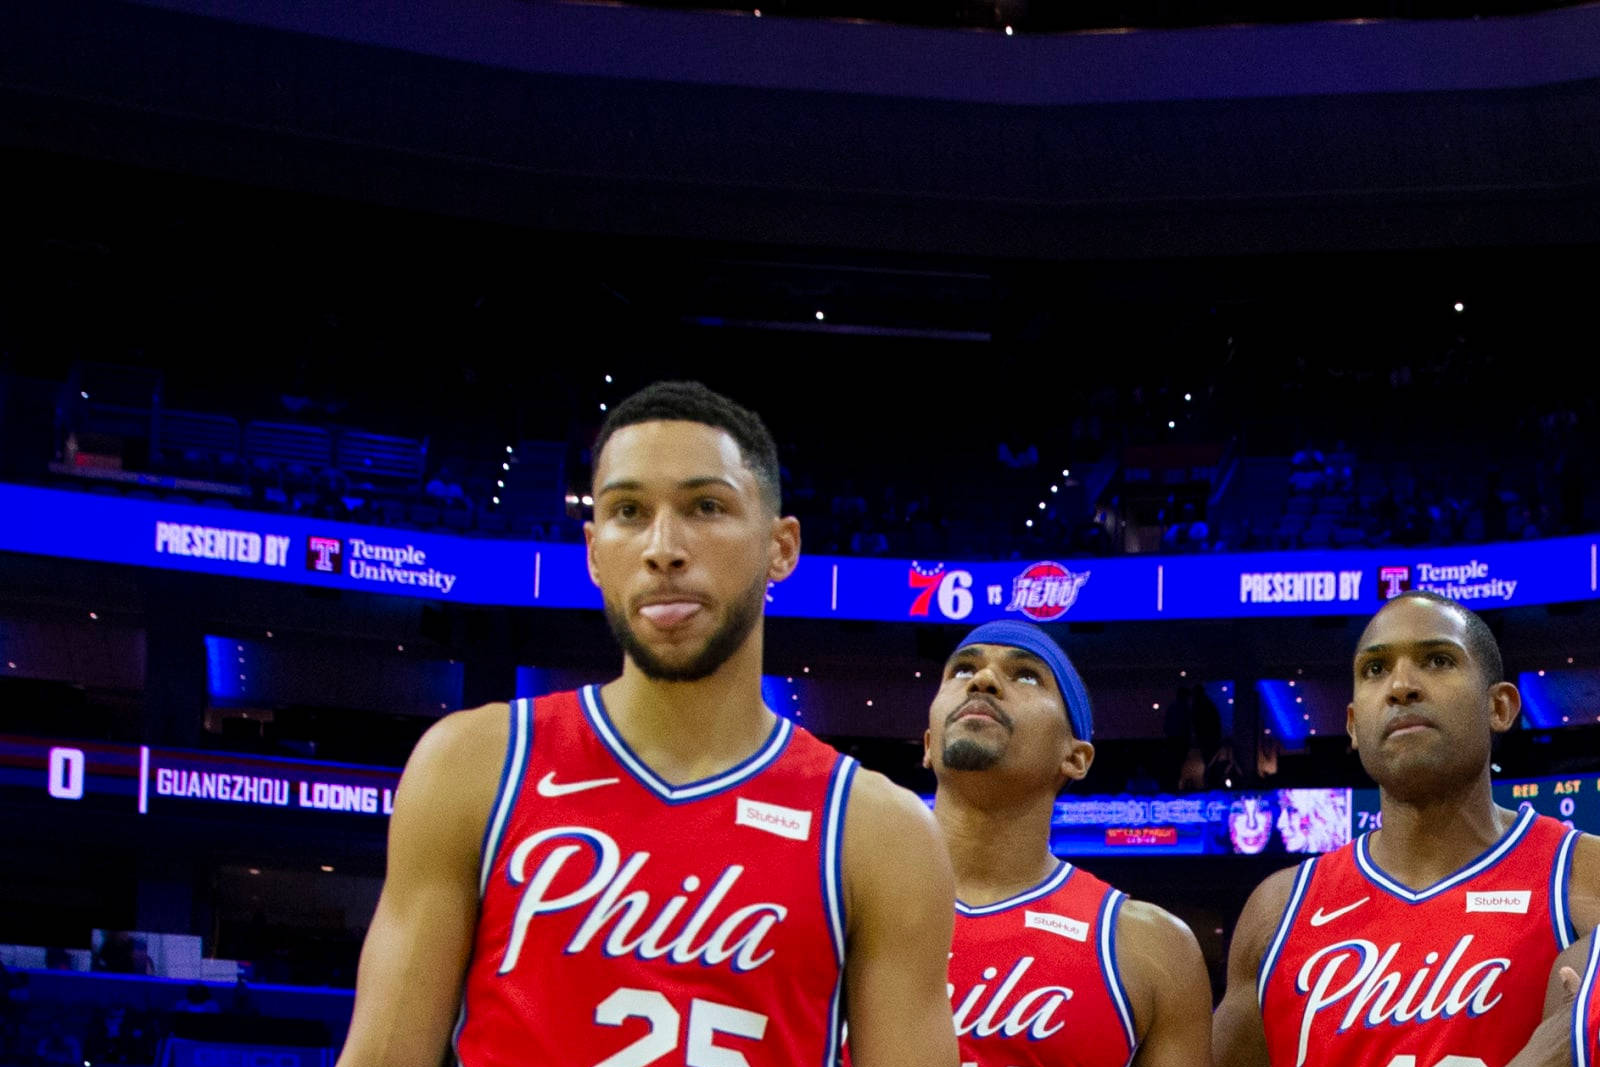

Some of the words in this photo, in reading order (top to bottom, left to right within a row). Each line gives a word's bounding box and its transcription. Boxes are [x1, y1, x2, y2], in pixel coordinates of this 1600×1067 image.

[156, 521, 261, 564] PRESENTED
[264, 534, 290, 567] BY
[349, 539, 426, 568] Temple
[350, 559, 456, 593] University
[1240, 572, 1337, 603] PRESENTED
[1339, 571, 1363, 601] BY
[1416, 560, 1489, 584] Temple
[157, 768, 290, 806] GUANGZHOU
[300, 781, 378, 814] LOONG
[1554, 780, 1582, 794] AST
[1560, 798, 1575, 817] 0
[496, 826, 788, 976] Phila
[1473, 896, 1522, 907] StubHub
[947, 953, 1074, 1041] ila
